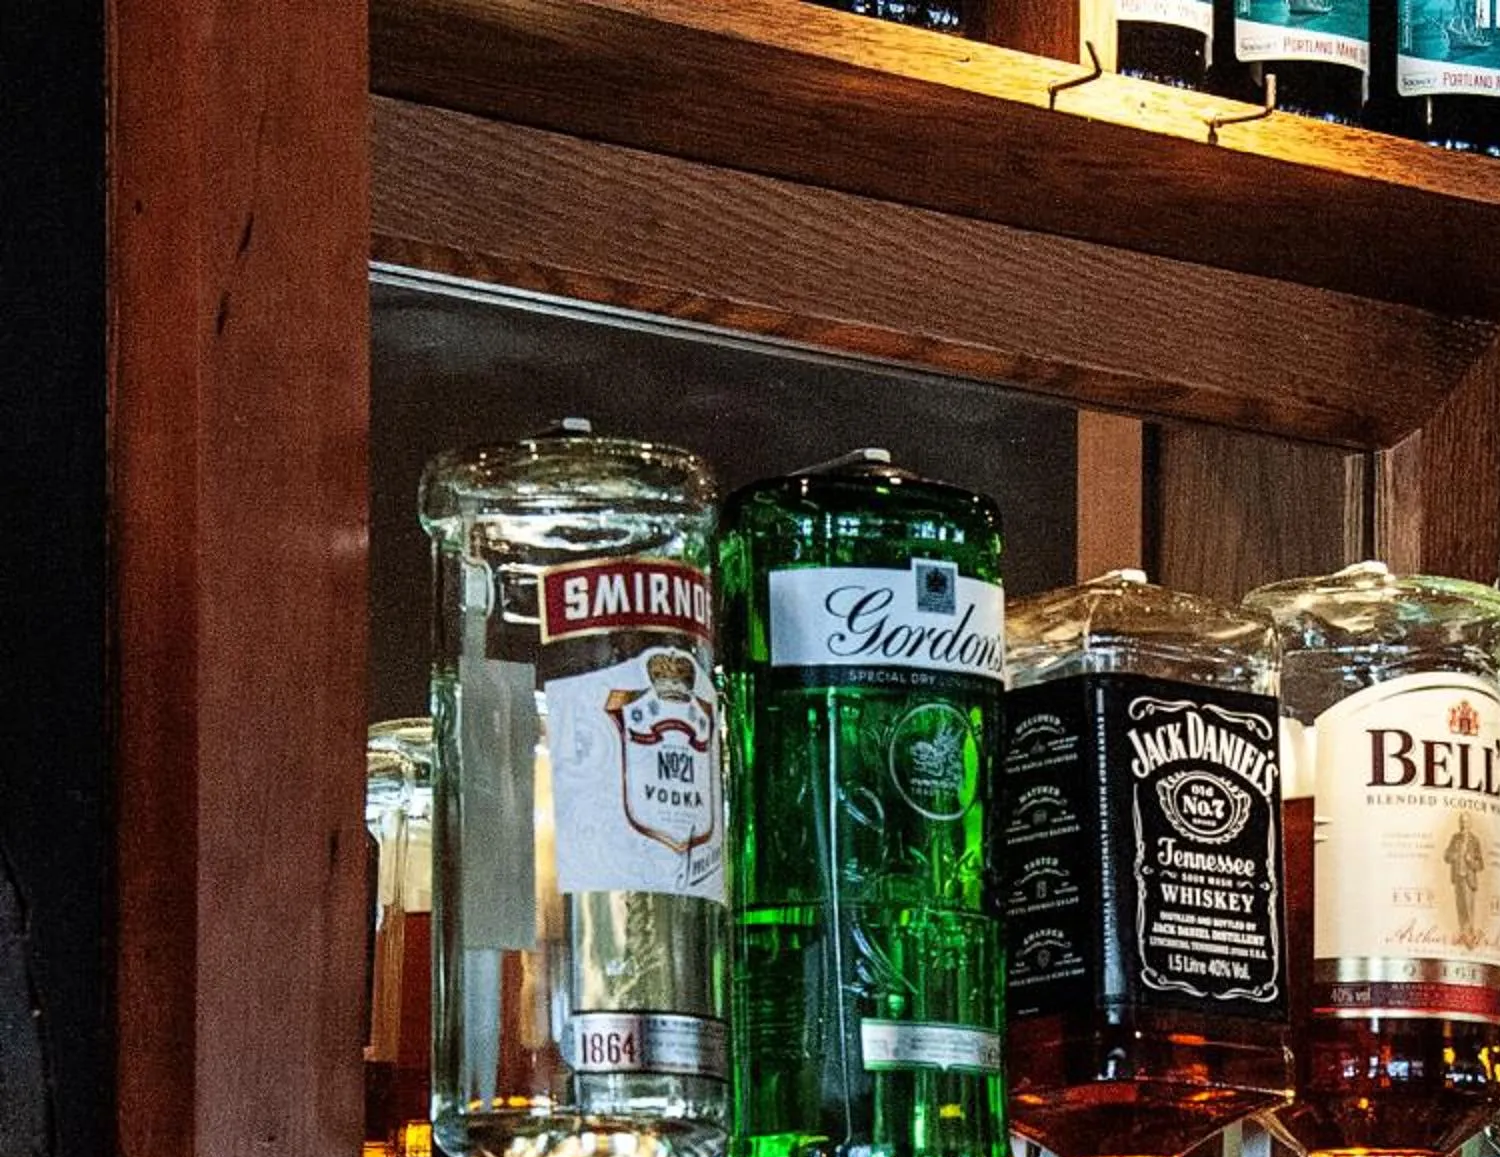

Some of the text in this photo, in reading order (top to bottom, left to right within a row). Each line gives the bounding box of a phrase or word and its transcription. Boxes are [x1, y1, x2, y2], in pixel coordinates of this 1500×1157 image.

[1282, 36, 1333, 55] PORTLAND
[1442, 71, 1492, 89] PORTLAND
[849, 669, 906, 685] SPECIAL
[910, 673, 936, 686] DRY
[1127, 722, 1188, 778] JACK
[1186, 711, 1279, 797] DANIEL'S
[644, 784, 704, 809] VODKA
[1366, 794, 1438, 807] BLENDED
[1157, 837, 1256, 877] Tennessee
[1160, 883, 1255, 913] WHISKEY
[581, 1032, 635, 1065] 1864
